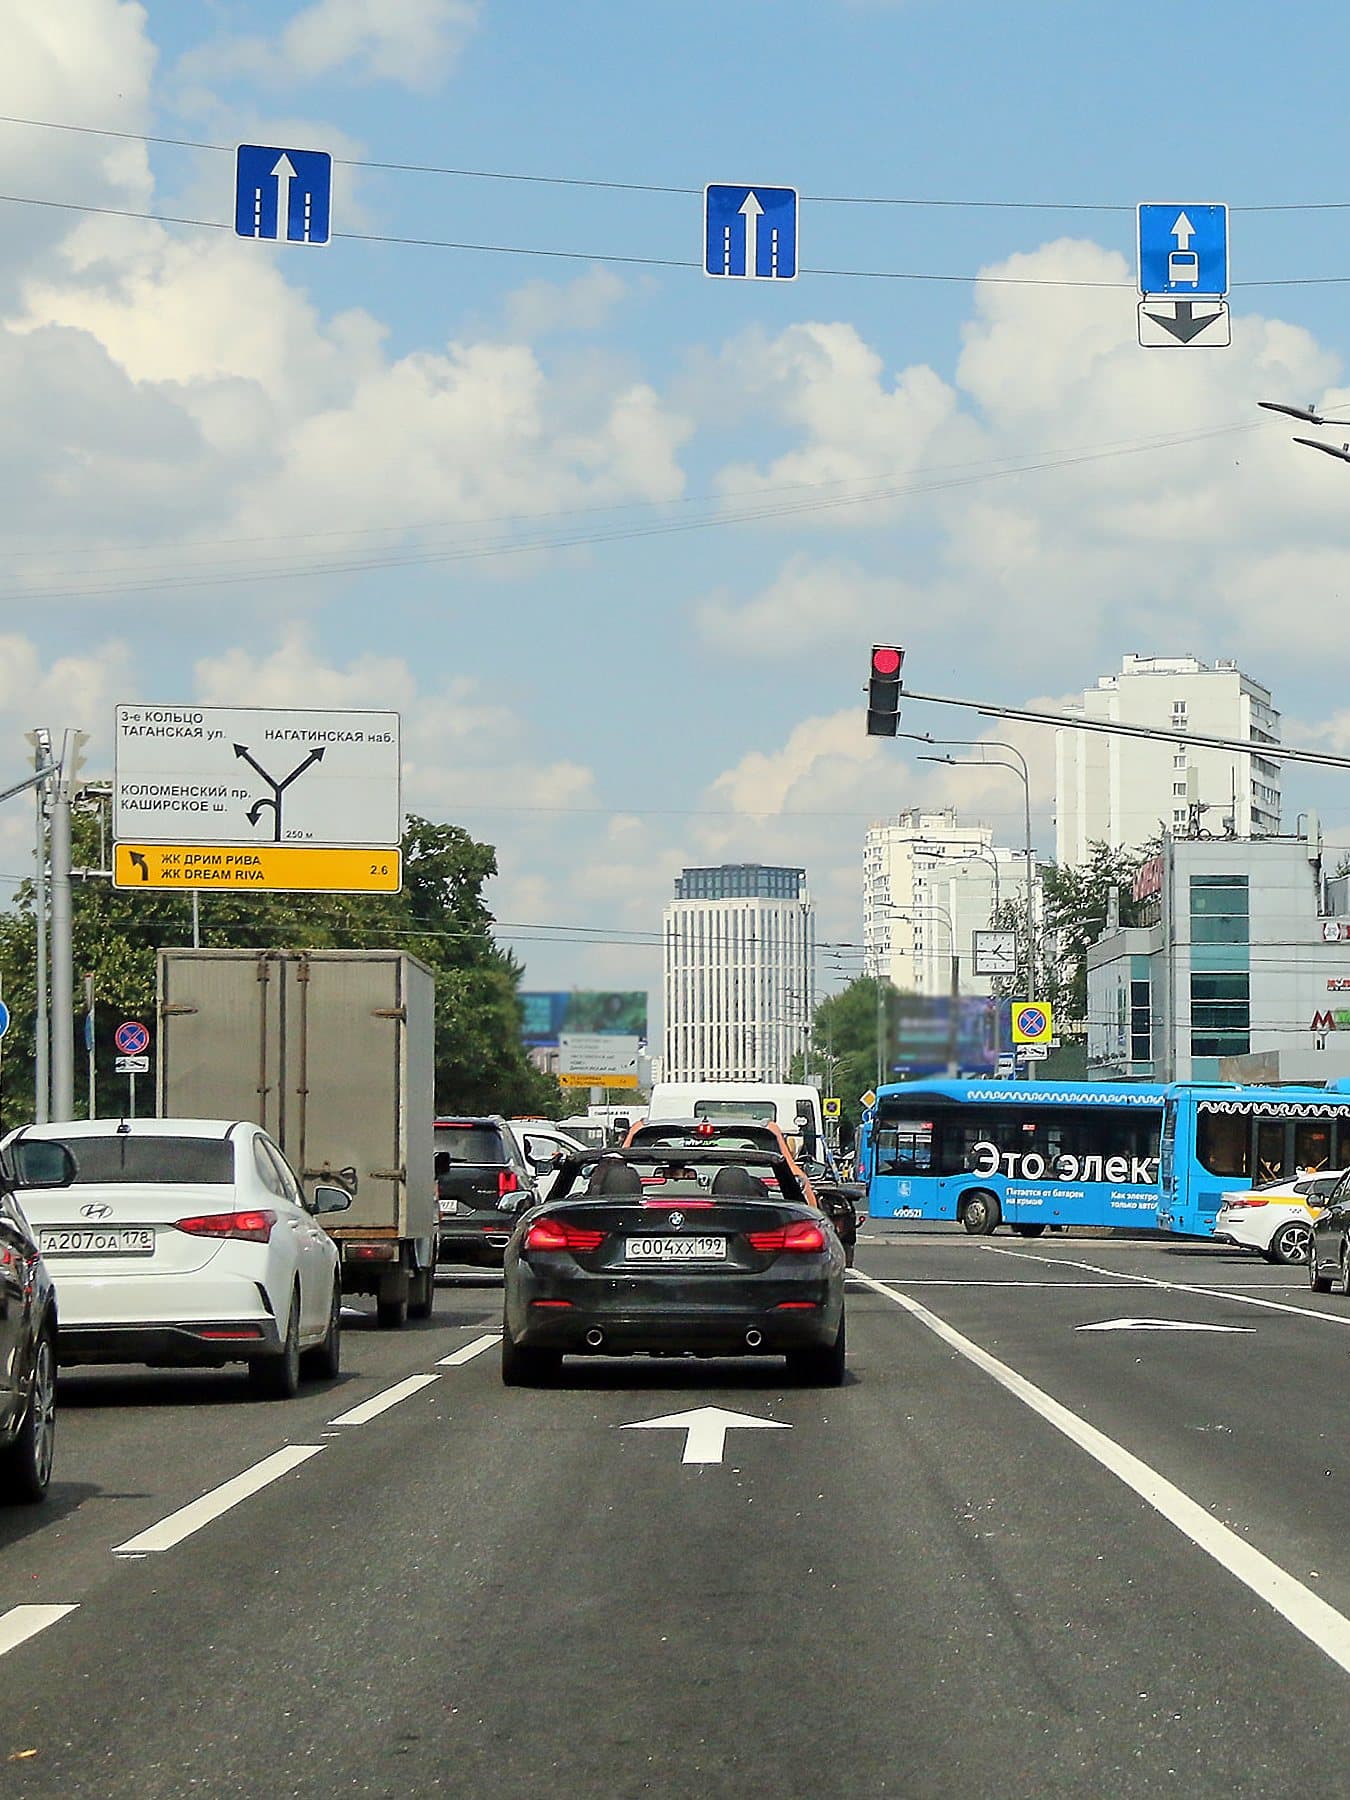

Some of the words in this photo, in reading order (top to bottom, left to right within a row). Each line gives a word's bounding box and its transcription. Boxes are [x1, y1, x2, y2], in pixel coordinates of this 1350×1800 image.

[121, 711, 141, 723] 3-е
[144, 711, 204, 724] КОЛЬЦО
[121, 725, 203, 739] ТАГАНСКАЯ
[207, 728, 226, 742] ул.
[265, 729, 364, 743] НАГАТИНСКАЯ
[367, 731, 396, 744] наб.
[121, 783, 228, 798] КОЛОМЕНСКИЙ
[231, 787, 251, 801] пр.
[121, 799, 209, 812] КАШИРСКОЕ
[212, 802, 228, 813] ш.
[286, 830, 304, 839] 250
[160, 853, 181, 865] ЖК
[183, 854, 222, 867] ДРИМ
[225, 855, 261, 866] РИВА
[160, 868, 181, 879] ЖК
[184, 868, 232, 880] DREAM
[235, 869, 265, 881] RIVA
[370, 864, 389, 876] 2.6
[973, 1140, 1046, 1181] Это
[893, 1208, 923, 1219] 490521
[121, 1231, 148, 1246] 178
[630, 1239, 695, 1255] С004ХХ
[697, 1238, 722, 1252] 199
